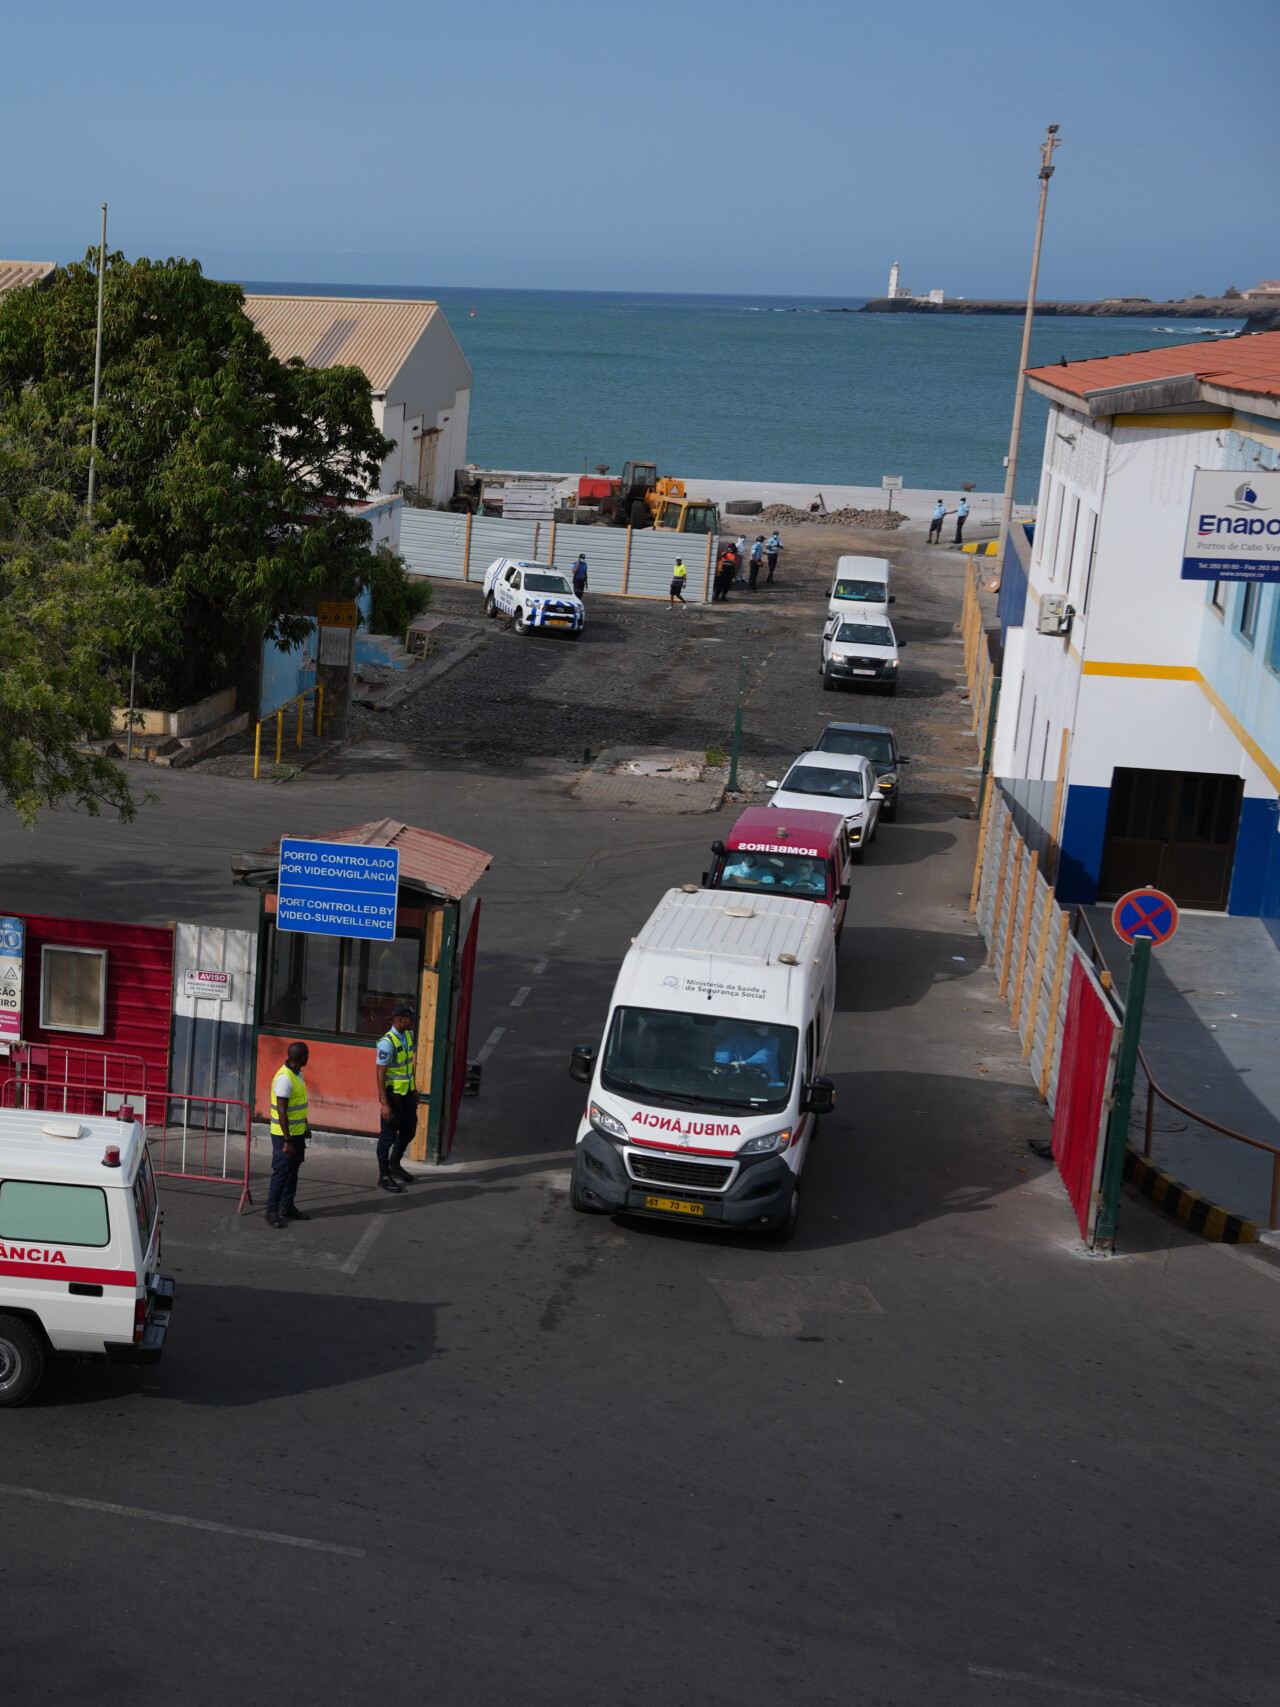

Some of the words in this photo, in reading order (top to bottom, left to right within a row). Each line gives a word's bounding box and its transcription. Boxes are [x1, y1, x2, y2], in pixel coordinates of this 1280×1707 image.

[1197, 542, 1226, 550] Portos
[1241, 543, 1263, 551] Cabo
[284, 851, 318, 861] PORTO
[321, 854, 394, 868] CONTROLADO
[281, 864, 302, 873] POR
[304, 866, 396, 882] VIDEO-VIGILÂNCIA
[280, 897, 306, 906] PORT
[307, 900, 378, 914] CONTROLLED
[379, 907, 394, 915] BY
[280, 911, 393, 928] VIDEO-SURVEILLENCE
[686, 980, 724, 988] Ministério
[737, 984, 760, 993] Saúde
[698, 986, 739, 997] Segurança
